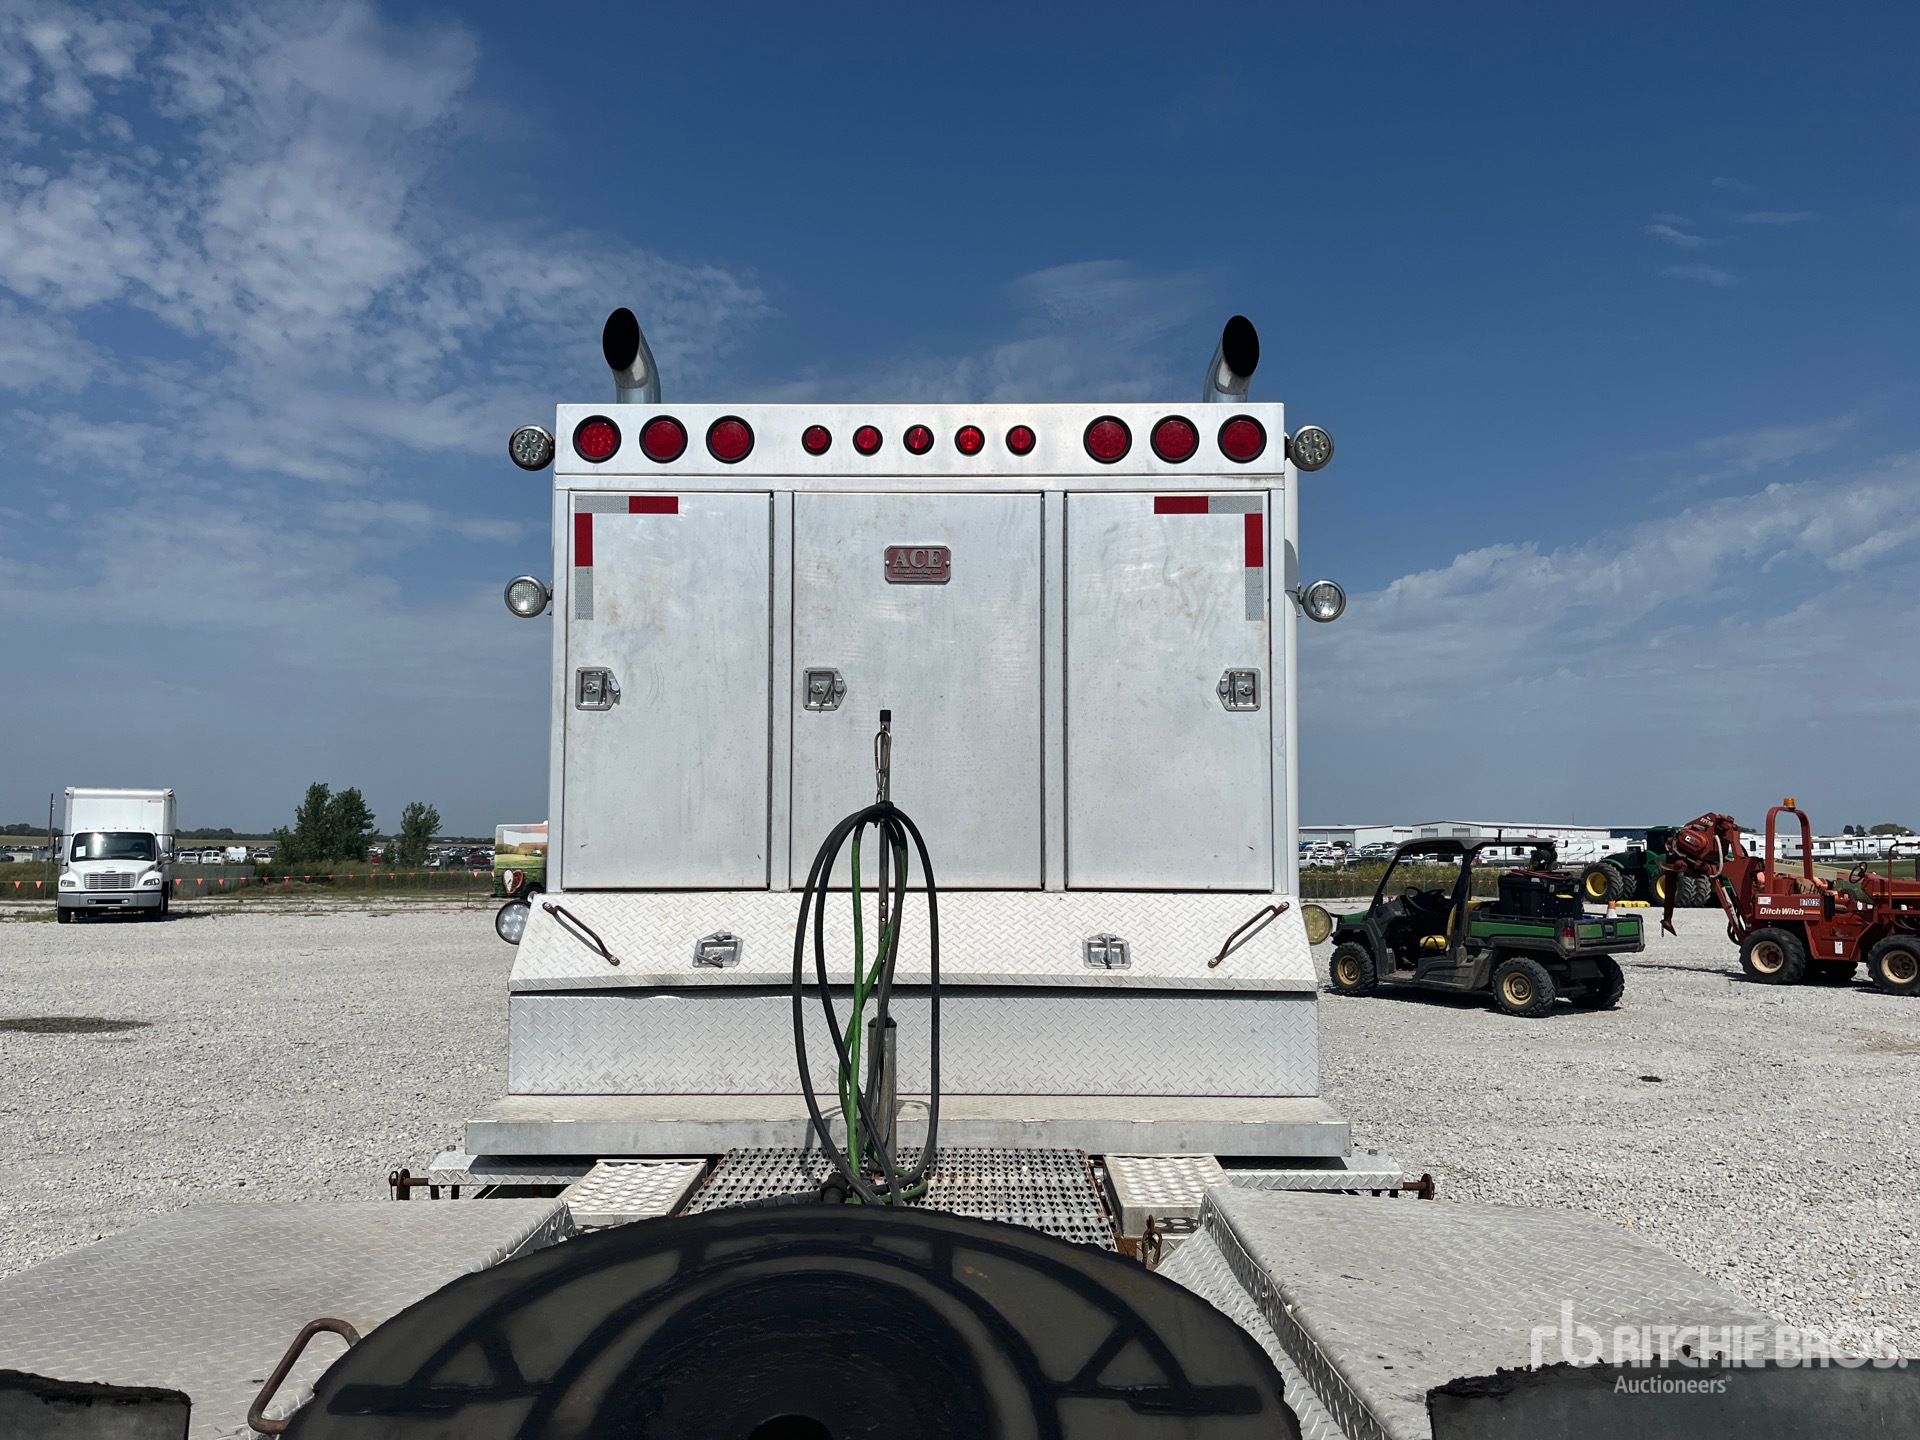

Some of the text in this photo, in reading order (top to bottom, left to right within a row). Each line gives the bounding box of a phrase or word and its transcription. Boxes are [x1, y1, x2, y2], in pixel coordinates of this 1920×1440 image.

[892, 548, 942, 568] ACE
[1760, 907, 1805, 916] Ditch Witch
